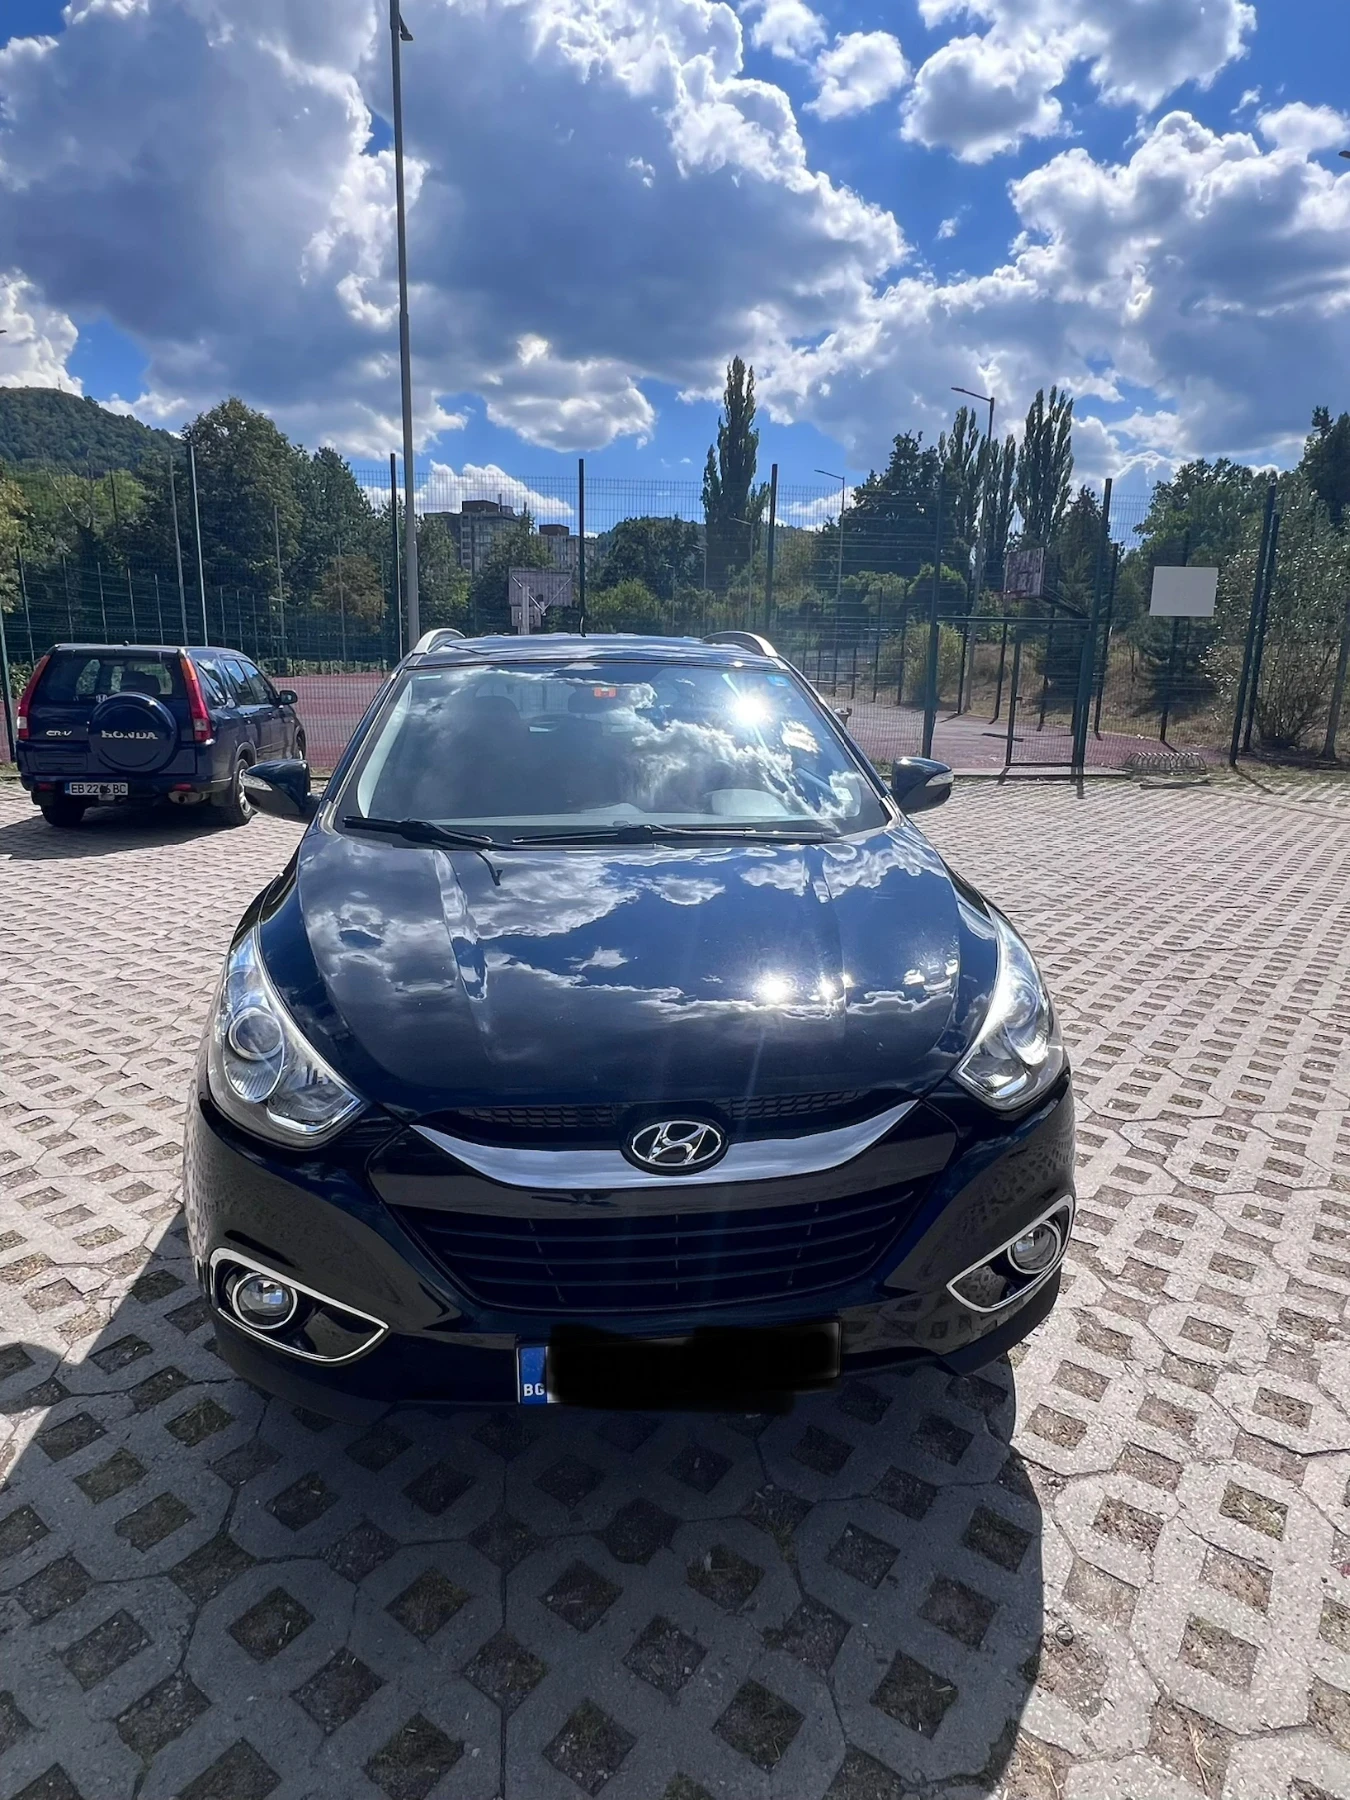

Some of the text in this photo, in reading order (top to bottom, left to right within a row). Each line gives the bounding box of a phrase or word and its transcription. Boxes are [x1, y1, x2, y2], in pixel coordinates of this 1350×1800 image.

[101, 730, 158, 740] HONDA
[71, 784, 85, 794] EB
[112, 784, 127, 794] BC
[523, 1382, 545, 1397] BG
